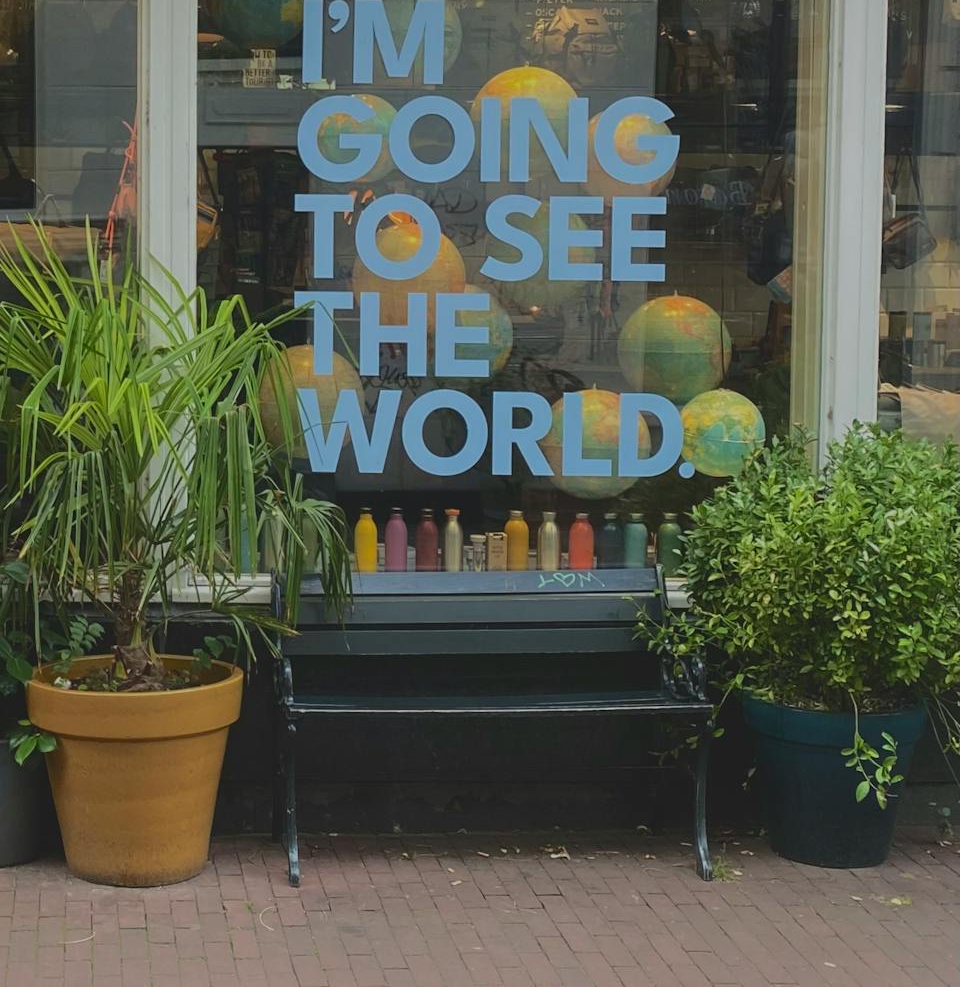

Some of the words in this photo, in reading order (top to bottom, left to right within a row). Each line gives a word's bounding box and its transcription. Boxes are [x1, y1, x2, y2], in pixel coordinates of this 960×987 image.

[297, 95, 680, 184] GOING
[294, 193, 442, 281] TO
[481, 193, 668, 282] SEE
[294, 291, 490, 378] THE
[297, 387, 696, 479] WORLD.
